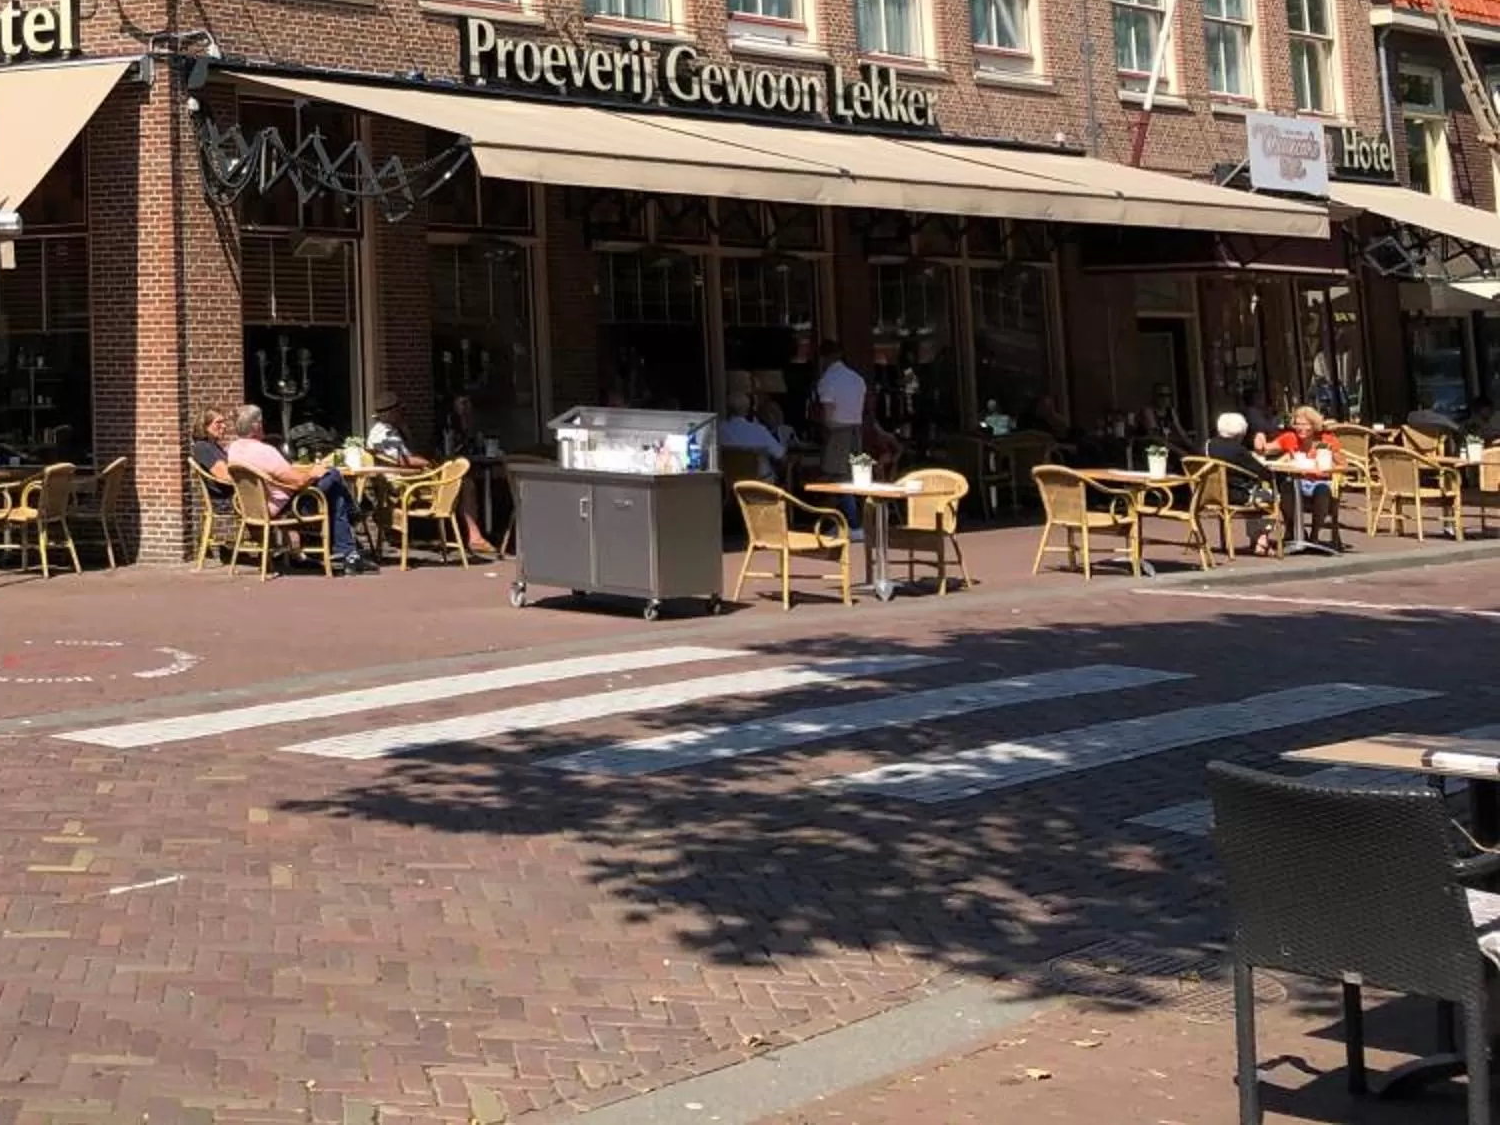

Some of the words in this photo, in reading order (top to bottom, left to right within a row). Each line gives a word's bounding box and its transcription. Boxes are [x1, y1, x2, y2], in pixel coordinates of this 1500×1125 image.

[467, 18, 653, 103] Proeverij
[665, 45, 822, 114] Gewoon
[835, 63, 939, 127] Lekker
